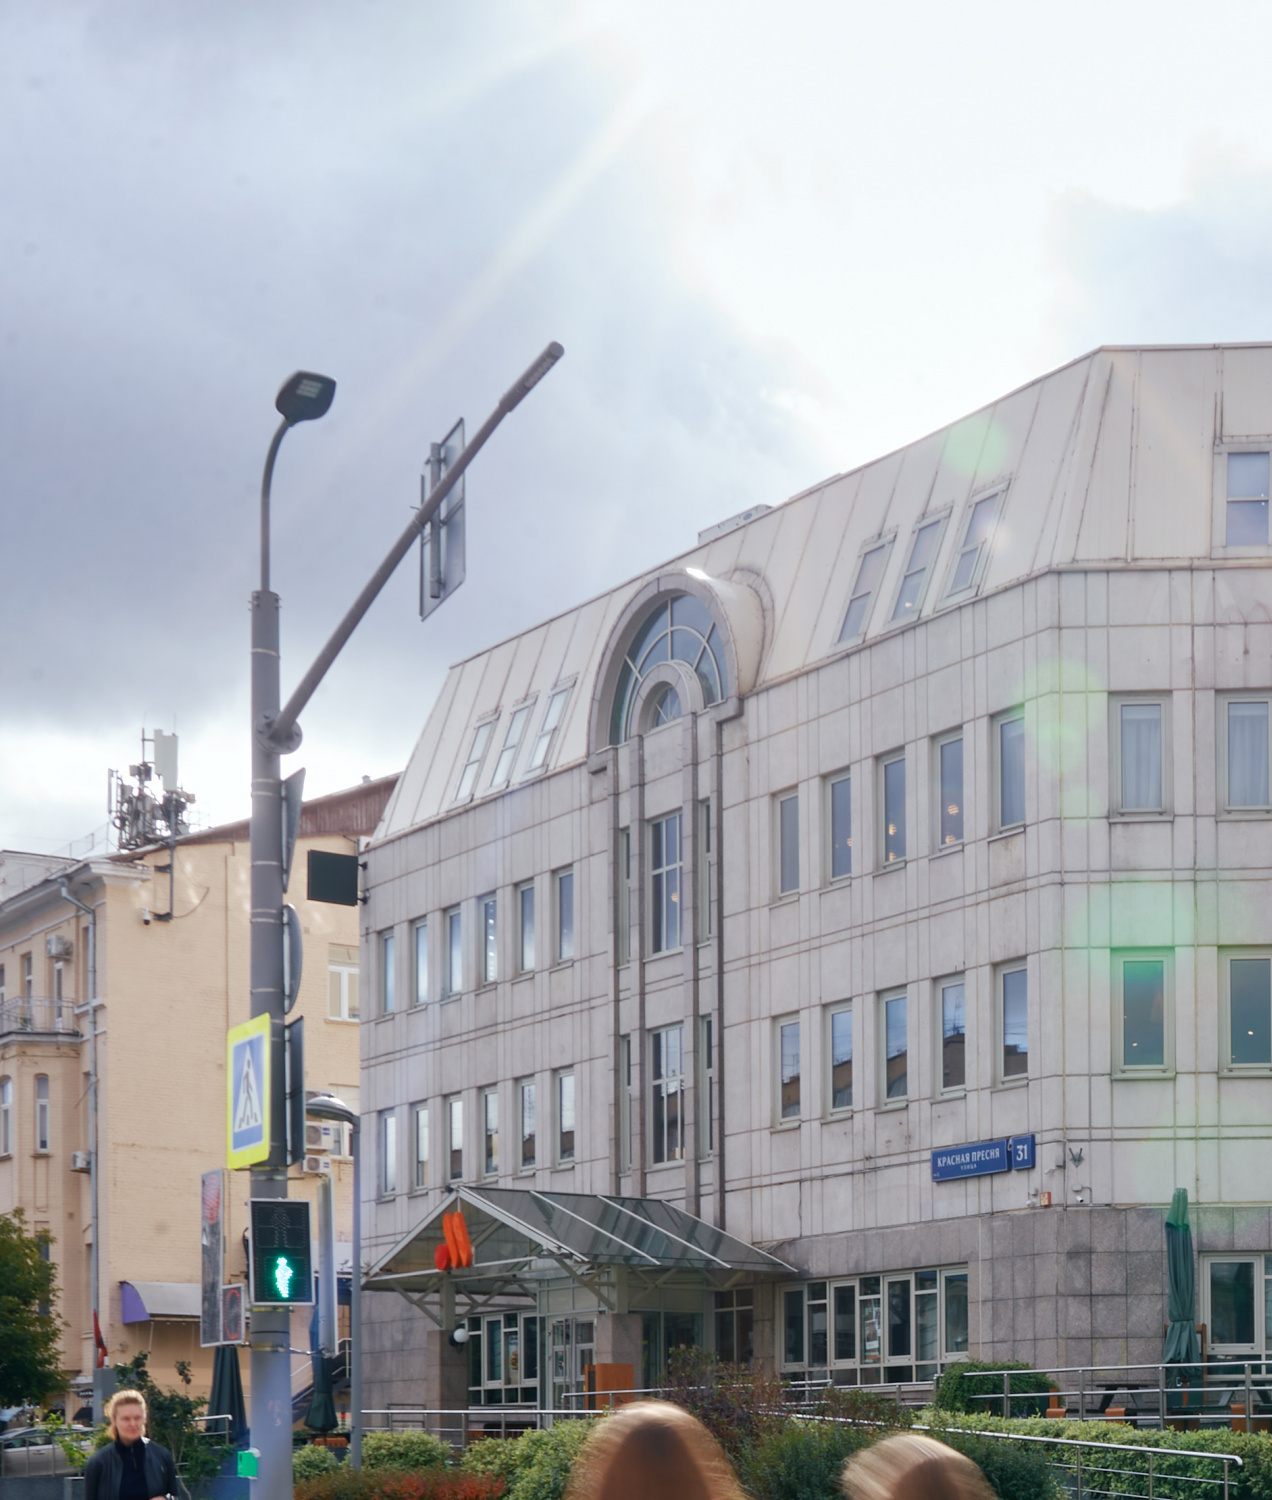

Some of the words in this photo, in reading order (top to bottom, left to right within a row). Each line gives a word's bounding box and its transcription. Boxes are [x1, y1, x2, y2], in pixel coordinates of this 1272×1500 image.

[937, 1152, 971, 1168] КРАСНАЯ
[971, 1147, 1000, 1163] ПРЕСНЯ
[1016, 1144, 1028, 1161] 31
[960, 1163, 977, 1171] УЛИЦА
